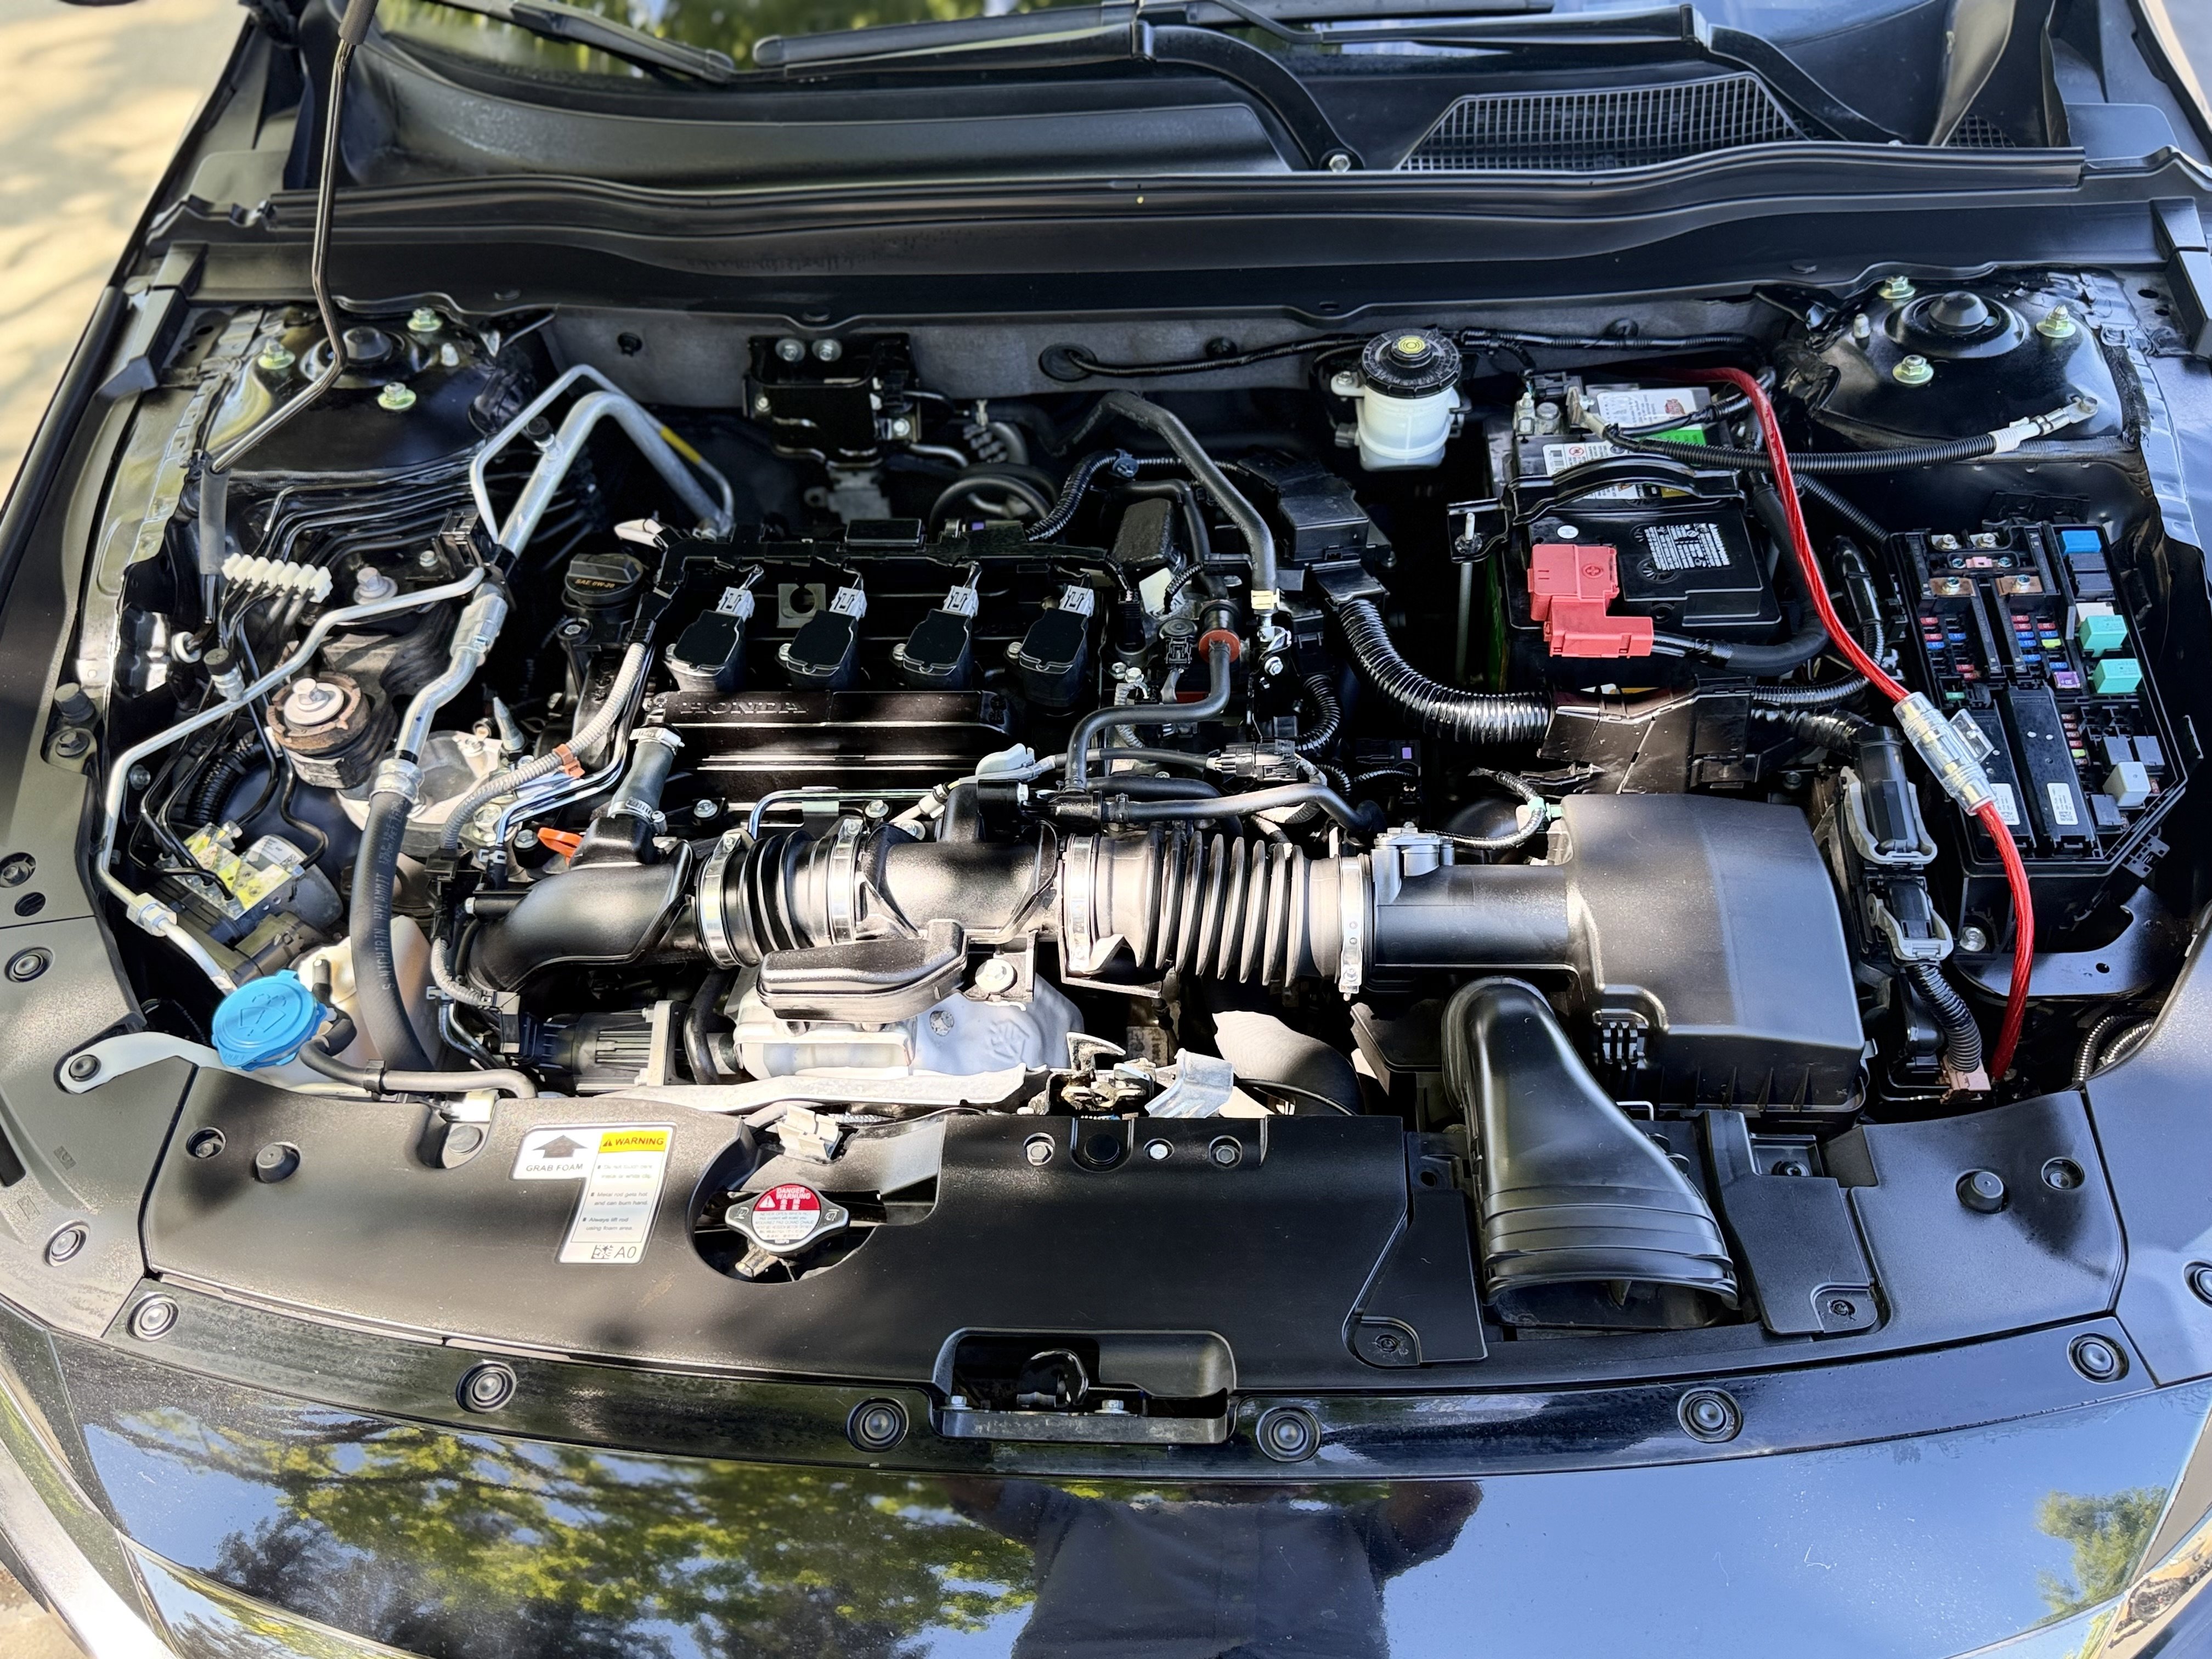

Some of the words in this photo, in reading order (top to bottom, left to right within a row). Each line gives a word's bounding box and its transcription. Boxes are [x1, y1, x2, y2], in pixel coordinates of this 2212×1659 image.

[681, 702, 806, 714] HONDA
[615, 1137, 664, 1146] WARNING
[614, 1246, 636, 1259] A0
